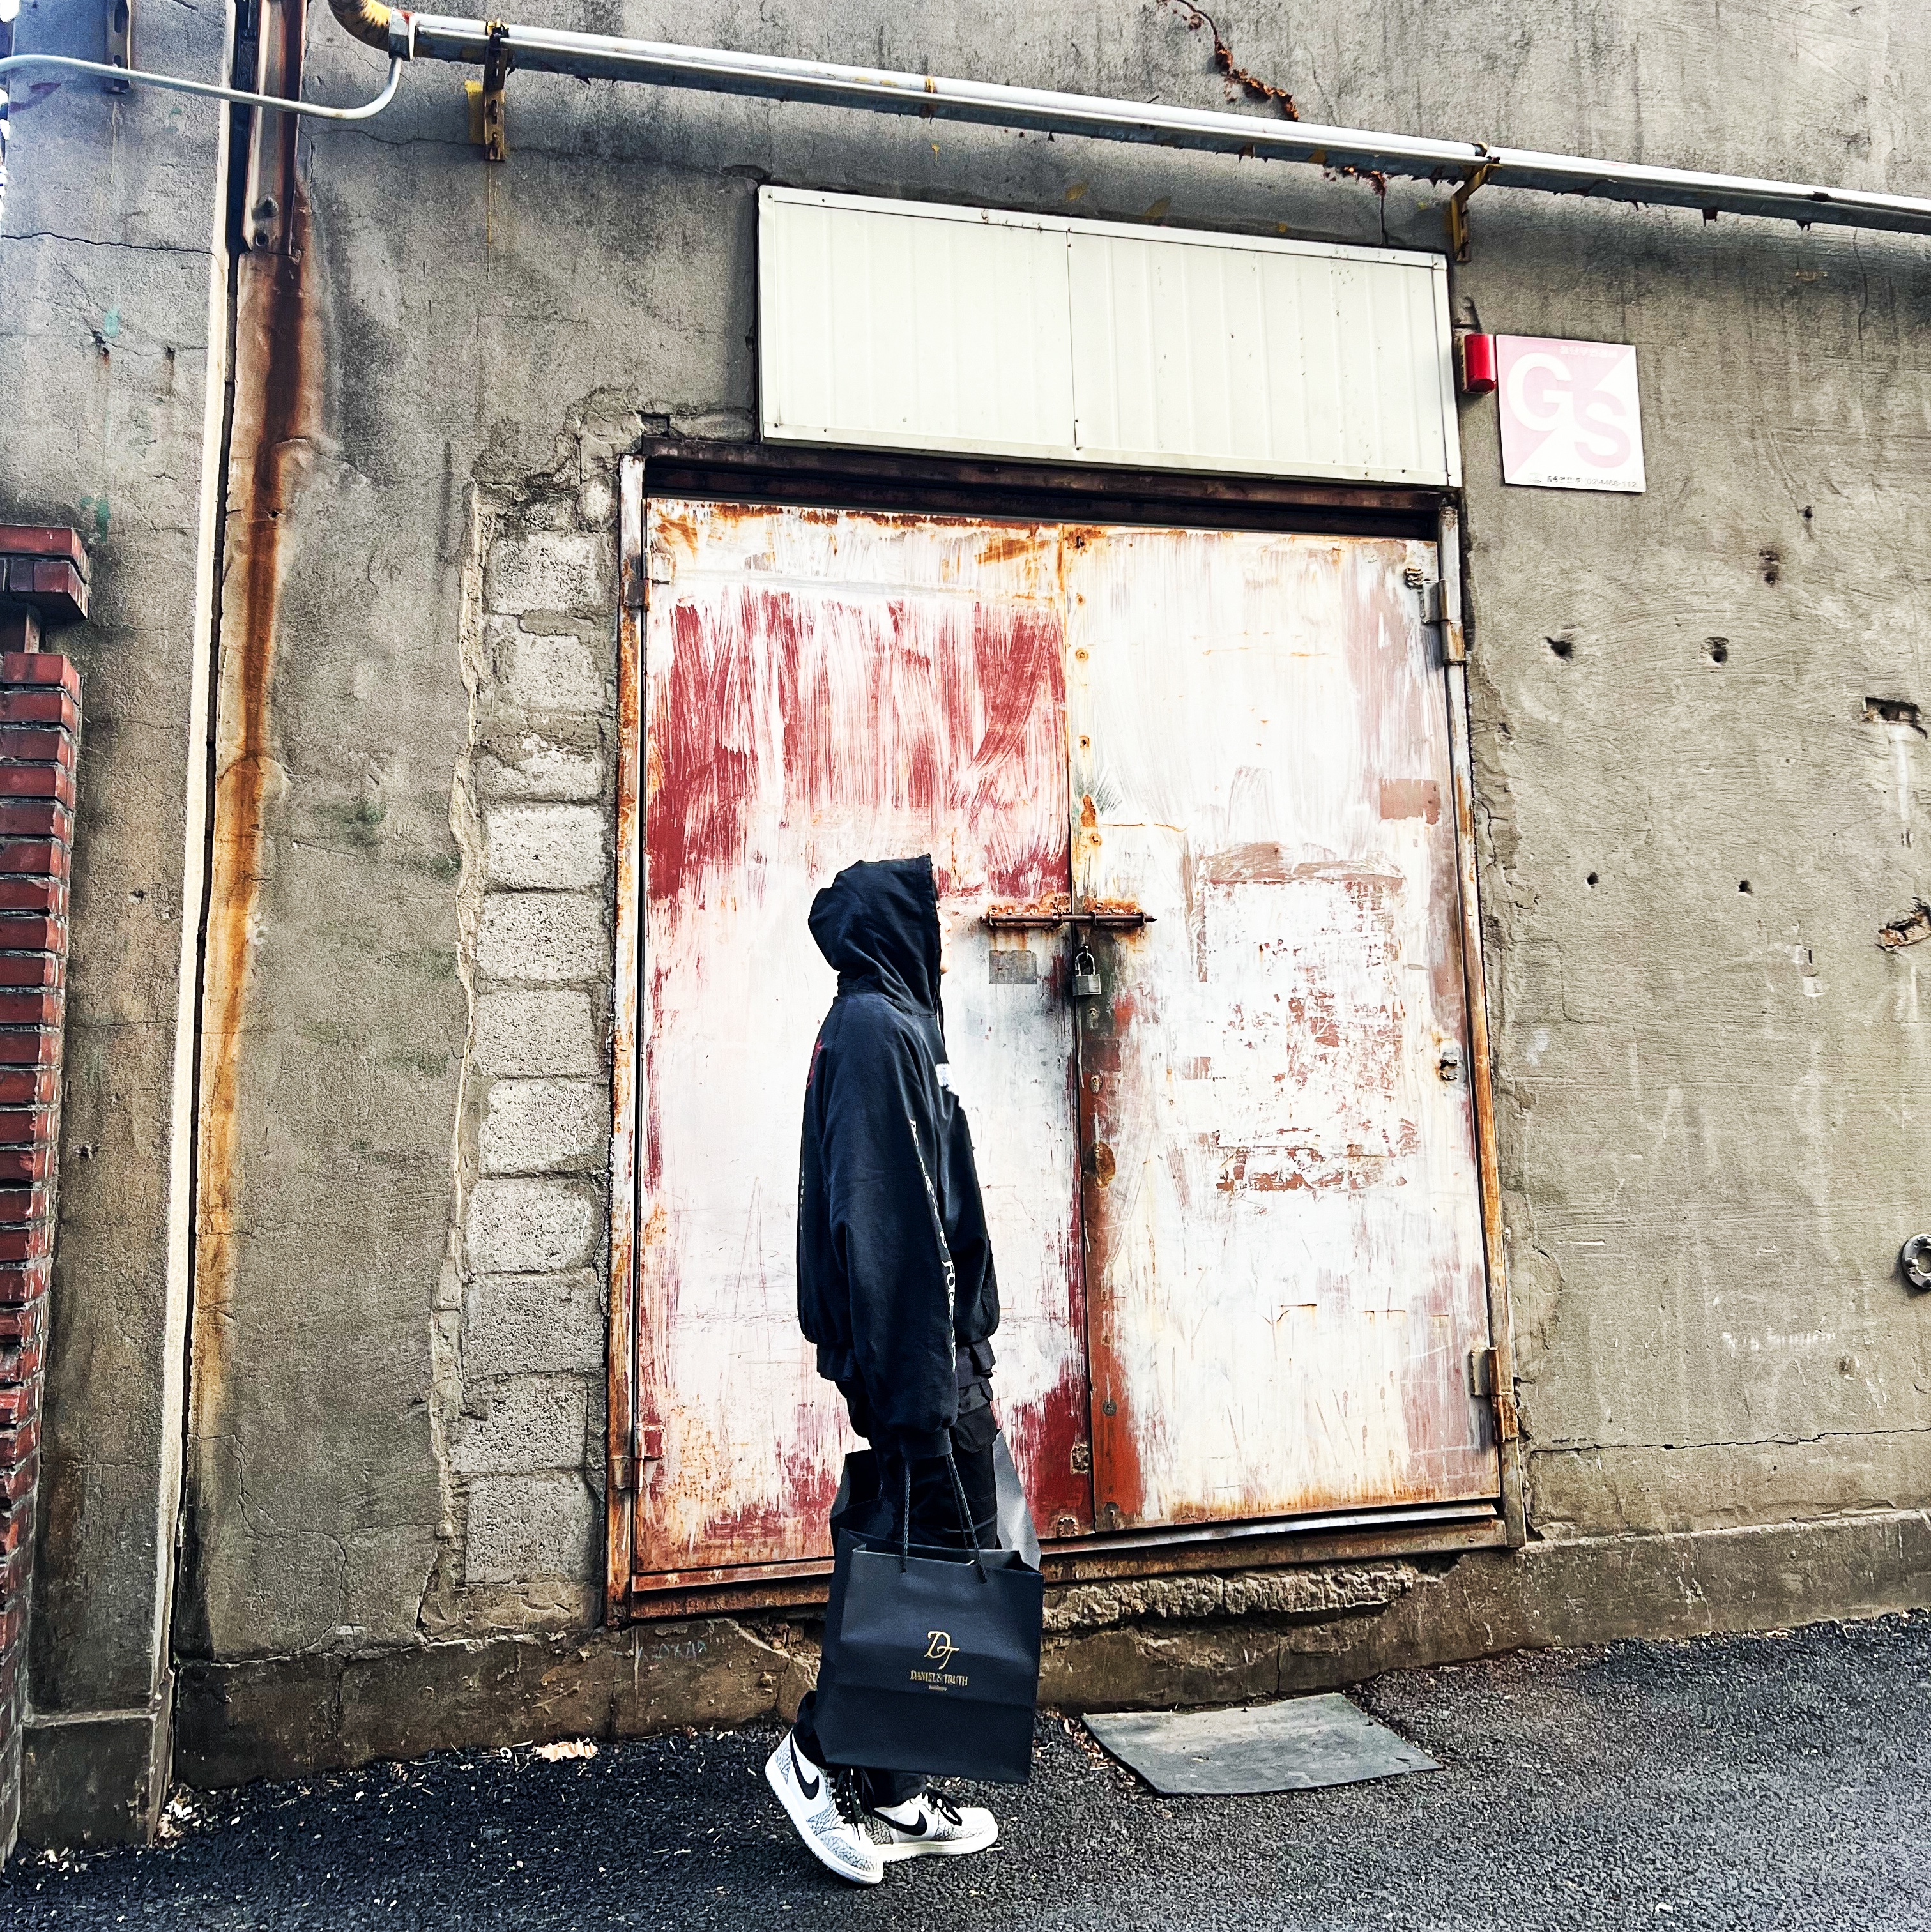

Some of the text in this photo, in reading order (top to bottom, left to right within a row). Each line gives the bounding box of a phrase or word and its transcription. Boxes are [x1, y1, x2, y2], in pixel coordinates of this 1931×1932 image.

[1507, 352, 1631, 468] GS
[910, 1670, 968, 1687] DANIEL'S TRUTH
